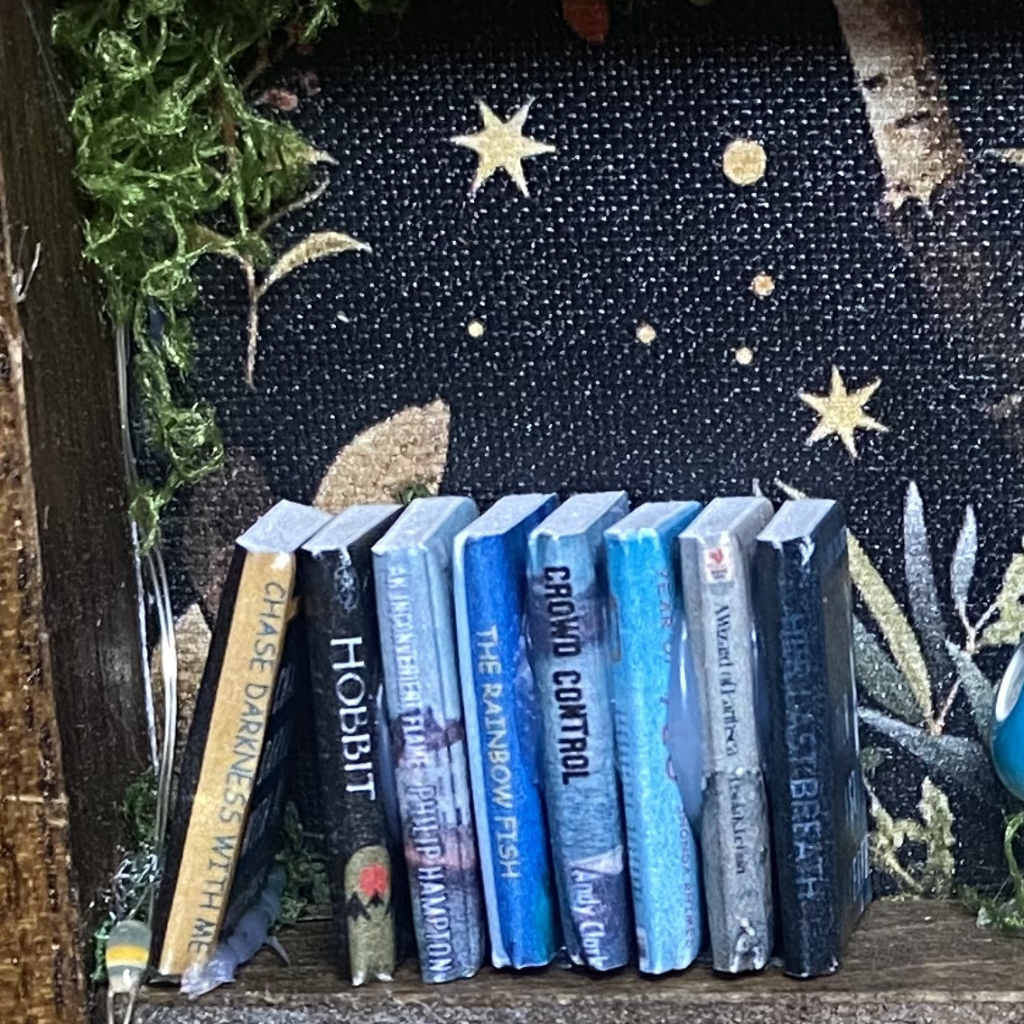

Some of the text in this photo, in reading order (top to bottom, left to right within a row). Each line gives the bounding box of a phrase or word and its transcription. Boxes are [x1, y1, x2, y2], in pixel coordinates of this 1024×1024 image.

[186, 580, 287, 955] CHASE DARKNESS WITH ME
[330, 636, 377, 801] HOBBIT
[475, 626, 523, 881] THE RAINBOW FISH
[552, 670, 592, 786] CONTROL
[406, 785, 442, 860] PHILIP
[789, 777, 824, 900] BREATH
[417, 867, 453, 972] HAMPTON
[571, 868, 604, 917] Andy
